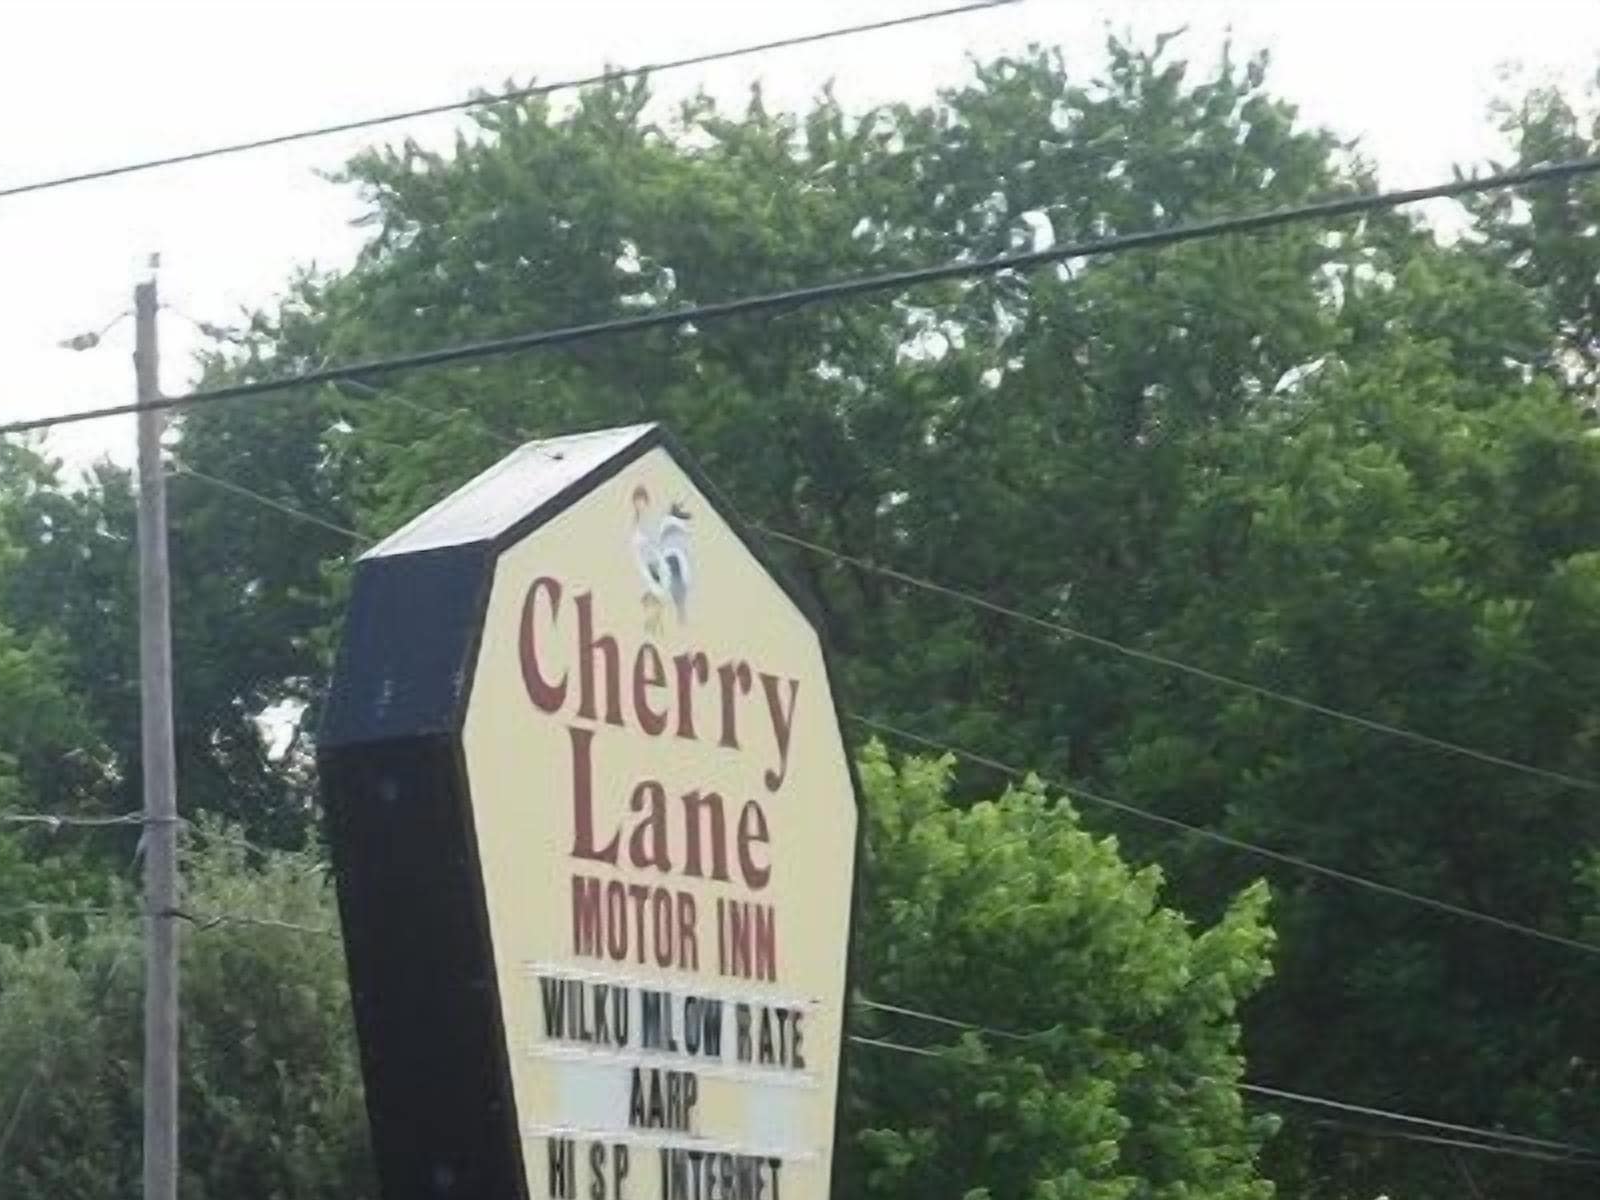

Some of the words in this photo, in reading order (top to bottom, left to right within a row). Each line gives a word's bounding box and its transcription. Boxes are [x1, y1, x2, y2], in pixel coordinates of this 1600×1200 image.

[519, 576, 799, 792] Cherry
[567, 727, 772, 891] Lane
[572, 873, 699, 971] MOTOR
[716, 897, 776, 983] INN
[736, 1002, 805, 1069] RATE
[629, 1067, 698, 1132] AARP
[548, 1137, 576, 1200] HI
